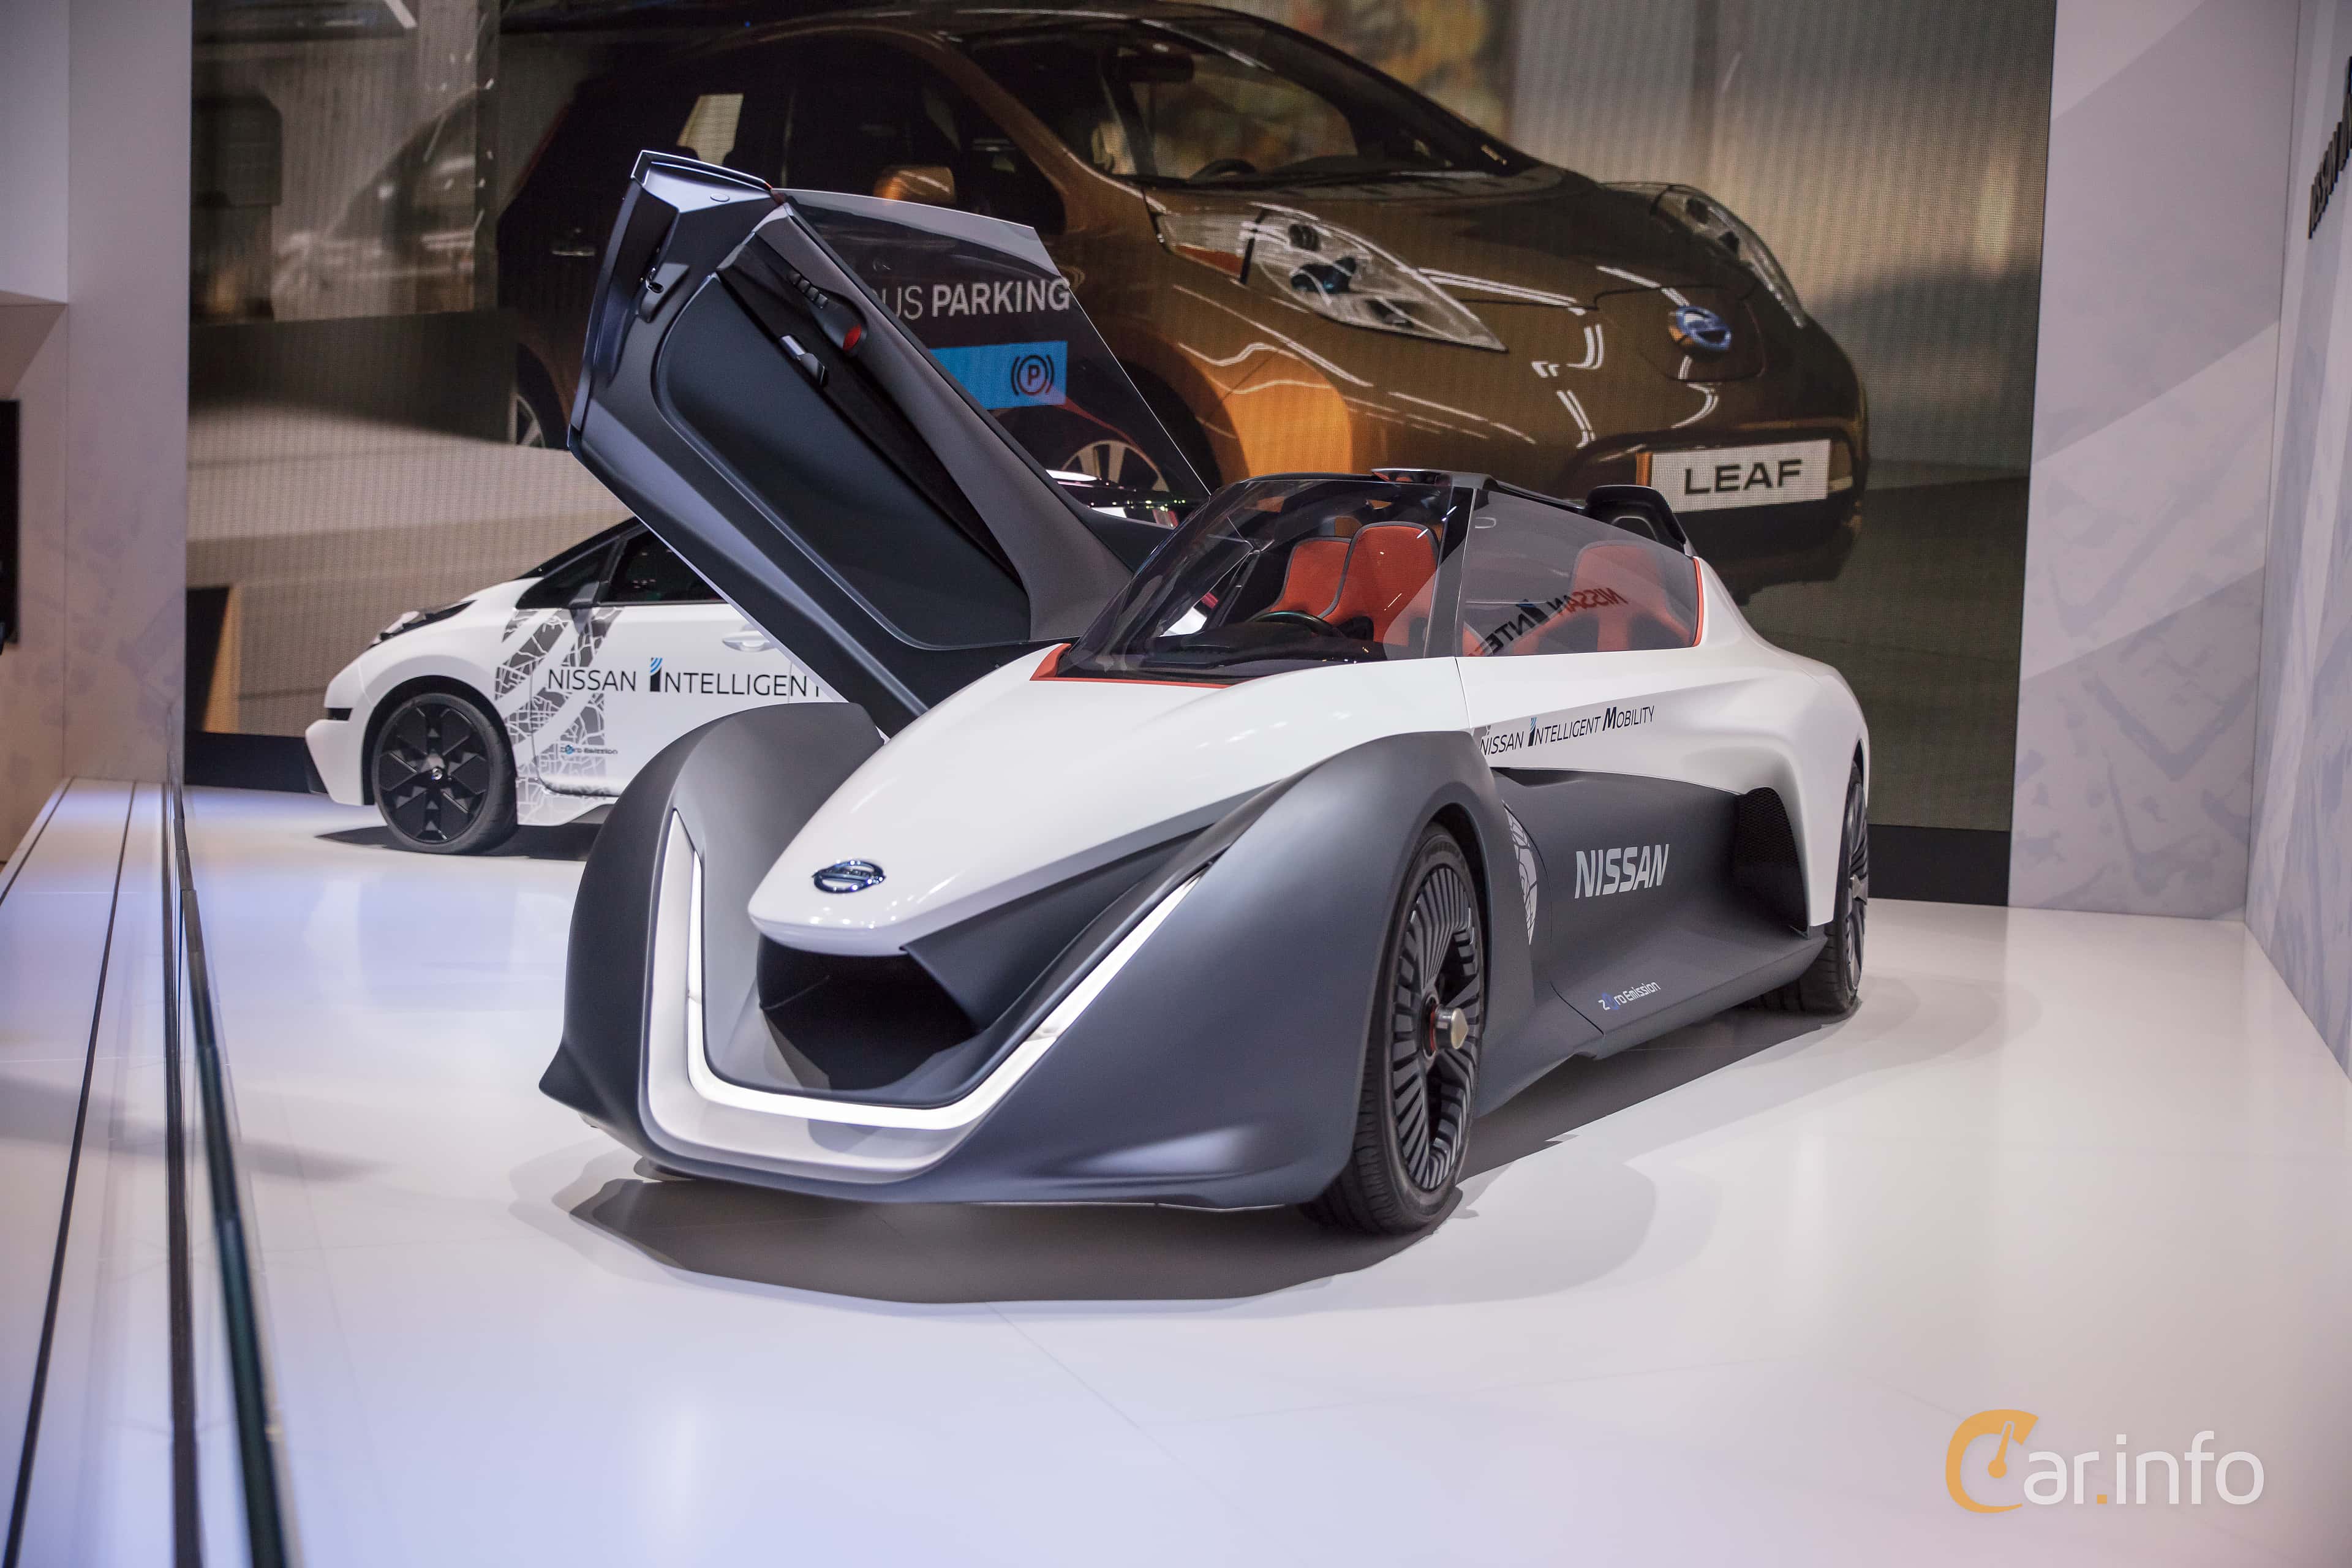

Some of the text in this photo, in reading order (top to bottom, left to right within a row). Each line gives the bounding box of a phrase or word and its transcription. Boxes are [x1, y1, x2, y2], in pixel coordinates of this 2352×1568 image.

[872, 276, 1071, 320] US PARKING
[1684, 459, 1803, 495] LEAF
[548, 668, 636, 692] NISSAN
[1480, 706, 1654, 755] NISSAN INTELLIGENT MOBILITY
[1574, 843, 1669, 899] NISSAN
[1623, 982, 1661, 1001] Emission
